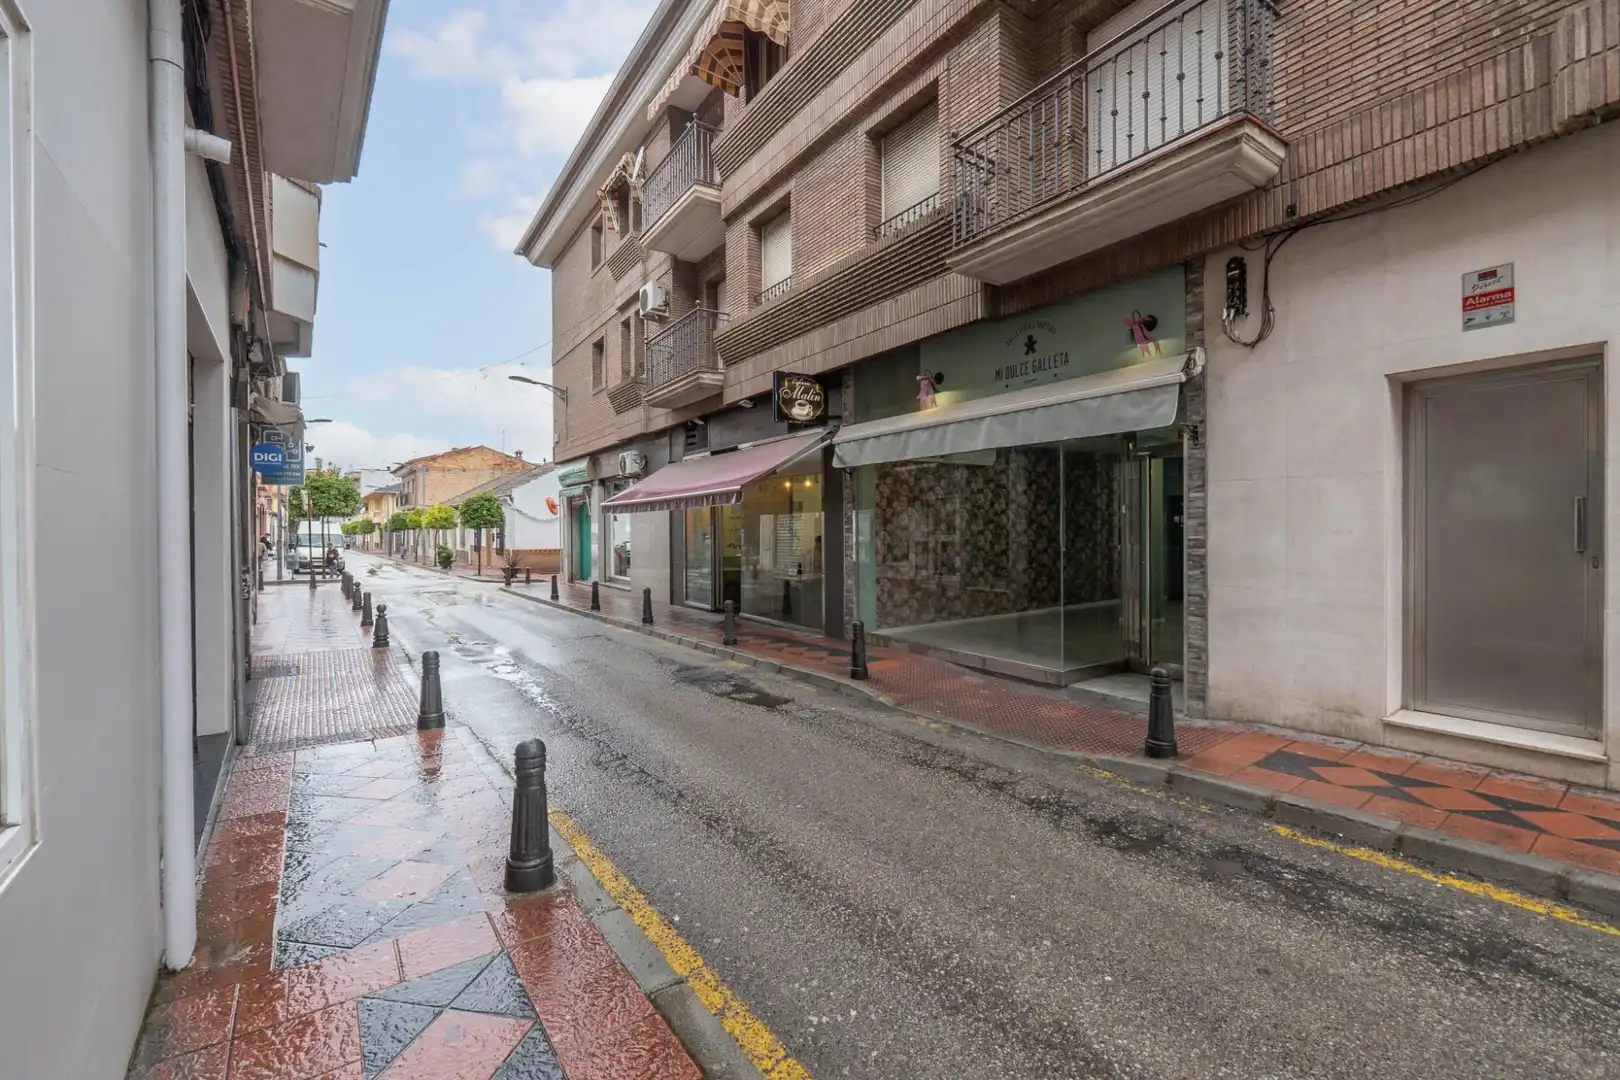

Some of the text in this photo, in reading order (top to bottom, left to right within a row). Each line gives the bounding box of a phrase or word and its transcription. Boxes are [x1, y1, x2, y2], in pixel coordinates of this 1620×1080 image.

[1466, 291, 1512, 306] Alarma
[1005, 361, 1030, 380] DULCE
[1032, 352, 1070, 374] GALLETA
[253, 452, 282, 462] DIGI
